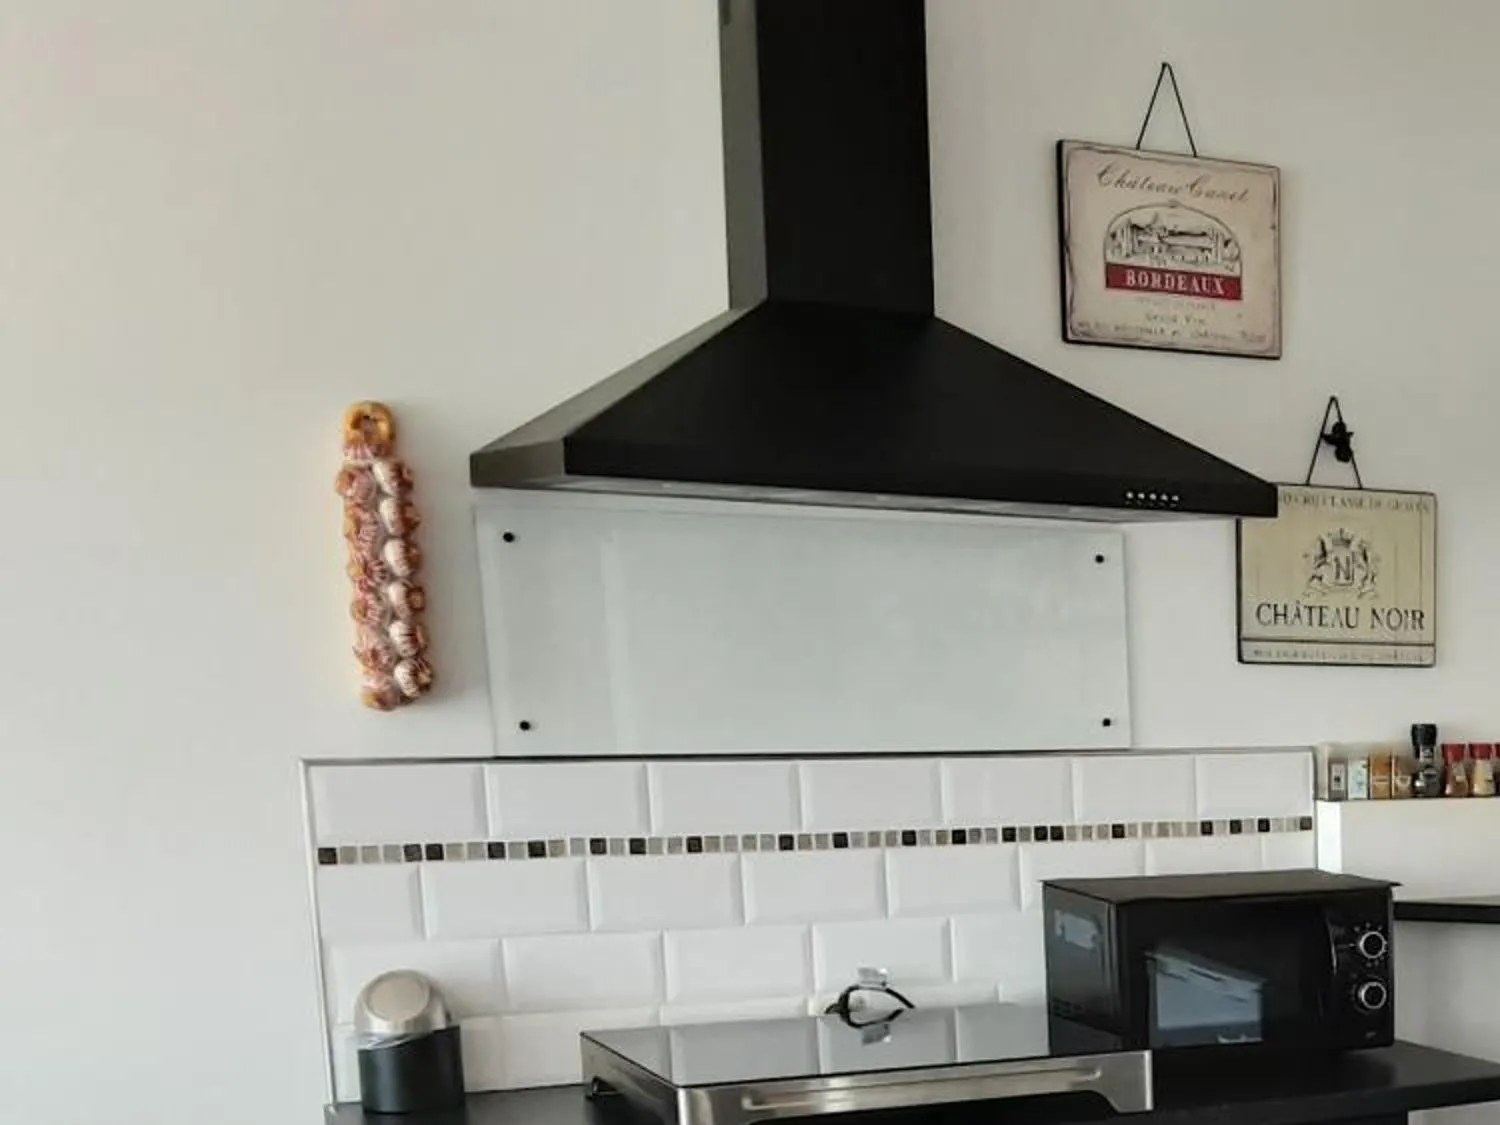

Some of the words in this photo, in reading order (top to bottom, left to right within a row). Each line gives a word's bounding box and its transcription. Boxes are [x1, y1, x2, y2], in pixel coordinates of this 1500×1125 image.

[1125, 269, 1225, 295] BORDEAUX
[1255, 600, 1360, 629] CHÂTEAU
[1370, 607, 1425, 631] NOIR
